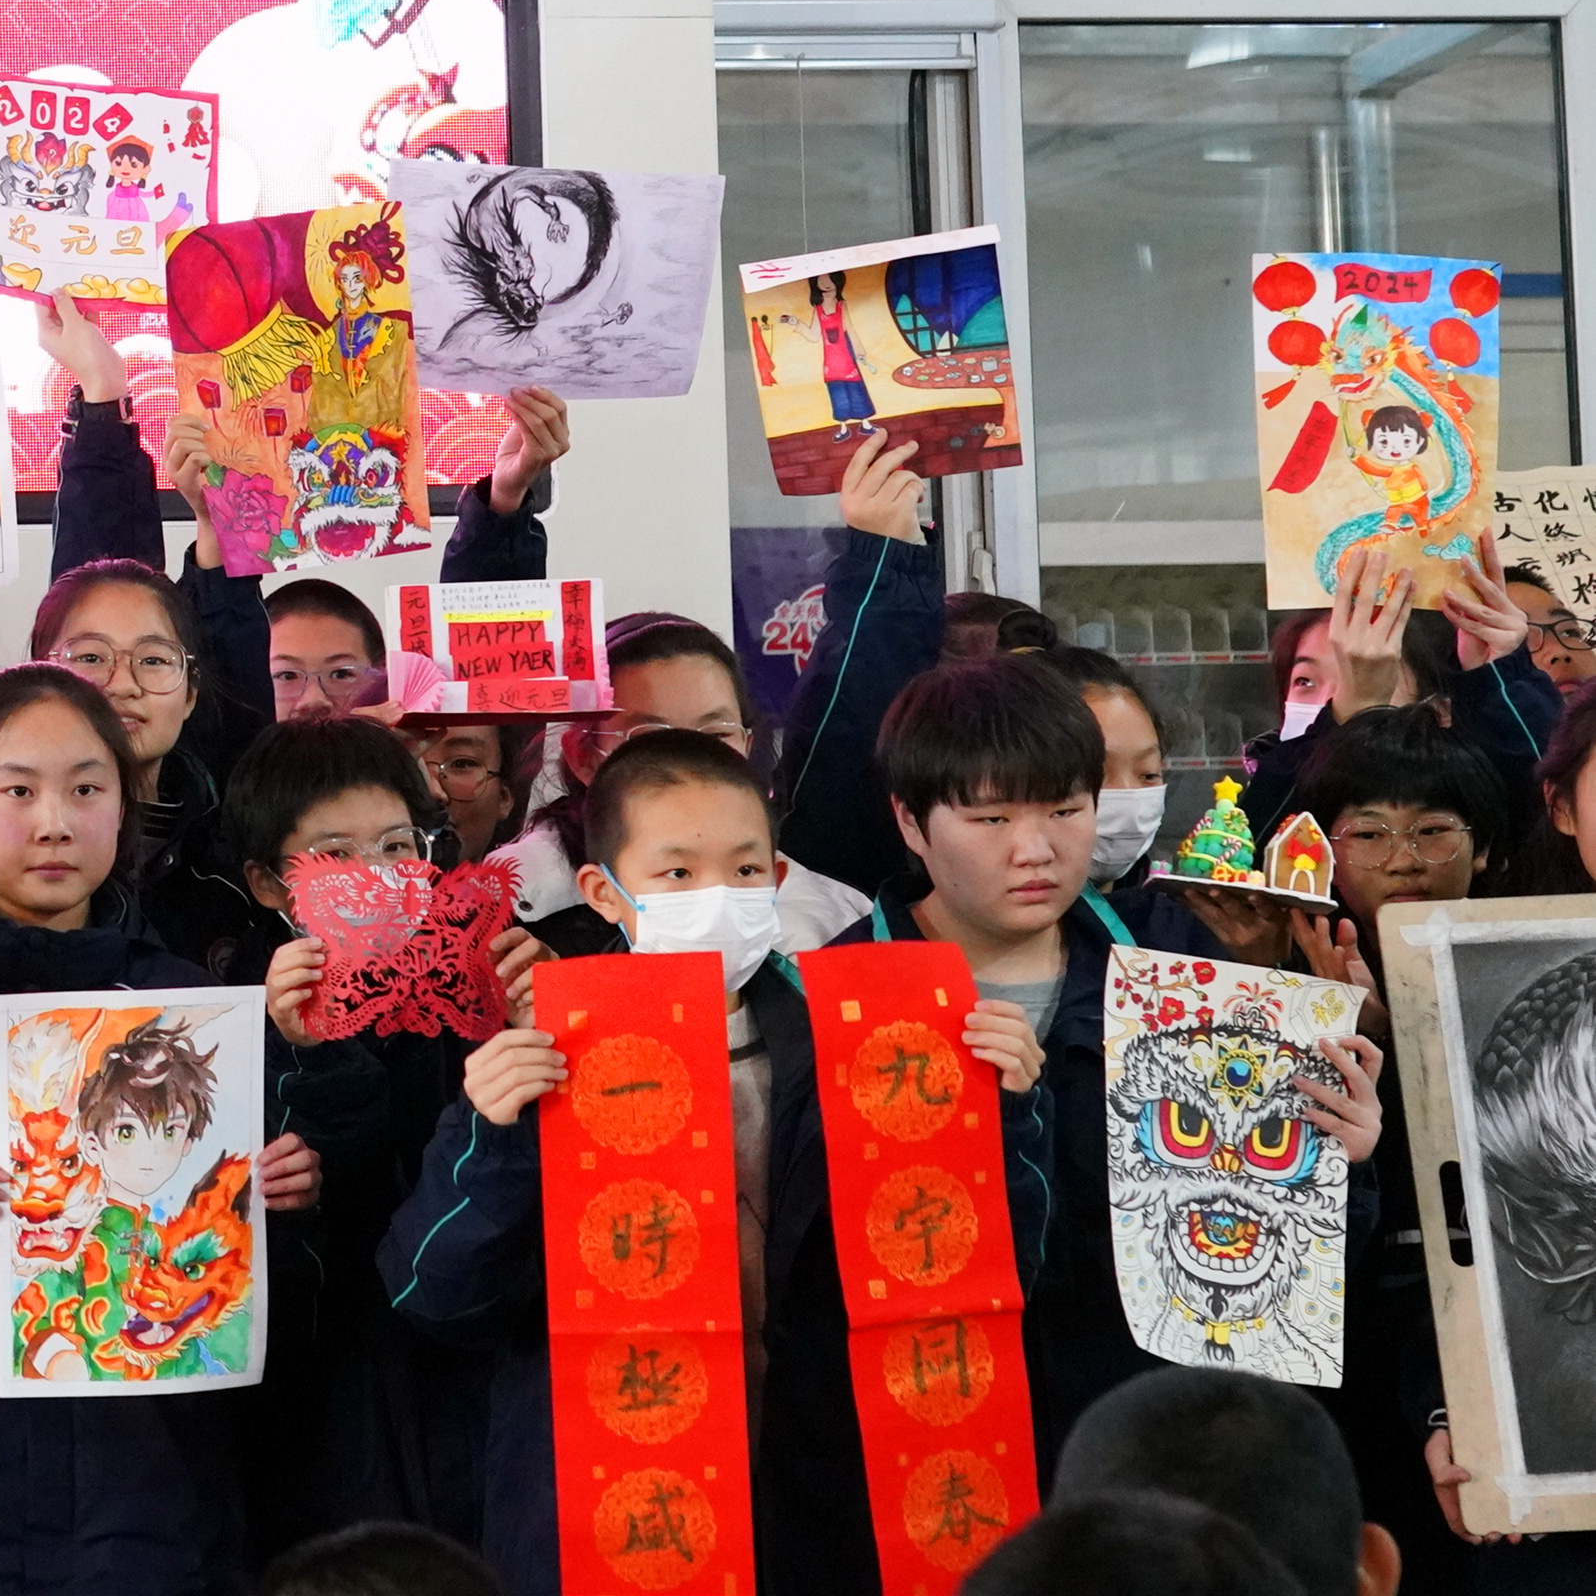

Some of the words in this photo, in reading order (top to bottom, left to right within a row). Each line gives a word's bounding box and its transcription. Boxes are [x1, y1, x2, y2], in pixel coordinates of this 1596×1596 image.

[1343, 271, 1418, 297] 2024
[457, 621, 541, 647] HAPPY
[766, 621, 812, 654] 24
[458, 657, 504, 679] NEW
[510, 651, 555, 673] YAER
[475, 684, 569, 711] 喜迎元旦
[1311, 988, 1346, 1028] 福
